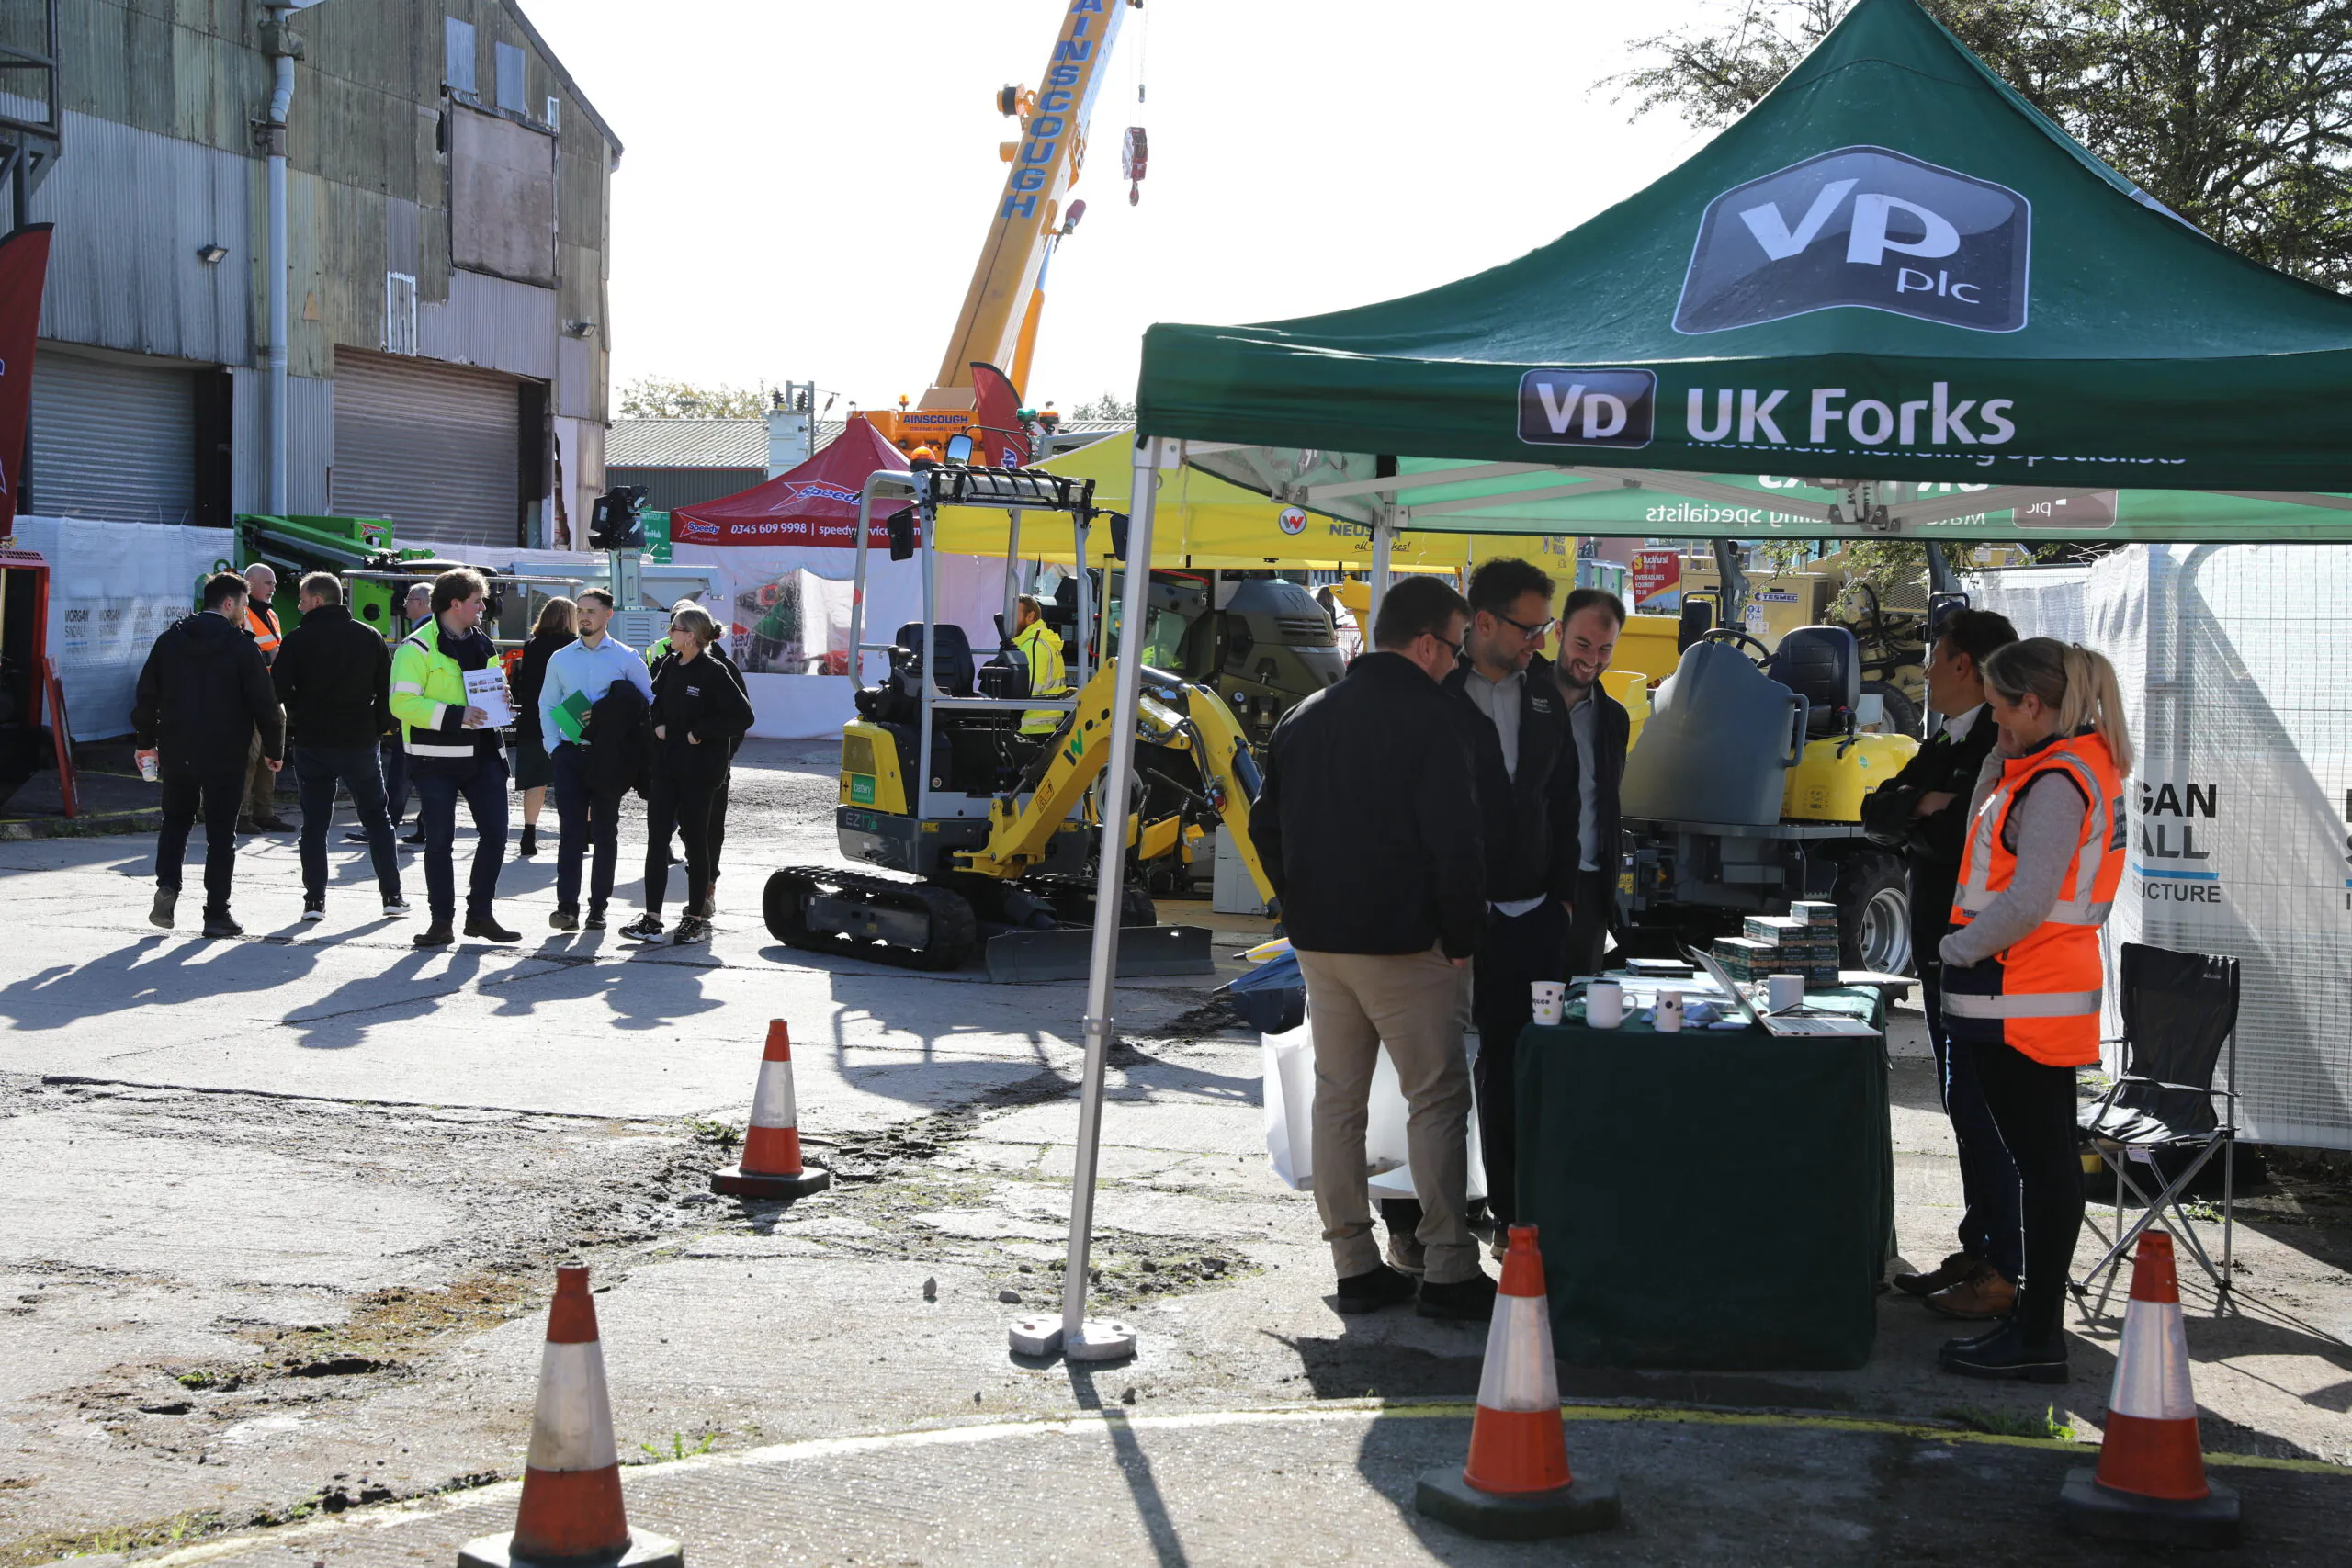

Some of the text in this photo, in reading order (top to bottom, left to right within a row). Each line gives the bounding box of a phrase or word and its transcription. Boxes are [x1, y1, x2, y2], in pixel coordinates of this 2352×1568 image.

[1000, 0, 1103, 219] AINSCOUGH
[1896, 267, 1981, 304] plc
[903, 414, 969, 424] AINSCOUGH
[1535, 382, 1627, 439] Vp
[1686, 381, 2016, 446] UK Forks
[687, 521, 720, 535] Speedy
[730, 524, 757, 535] 0345
[759, 523, 779, 534] 609
[780, 522, 807, 534] 9998
[854, 782, 872, 797] battery
